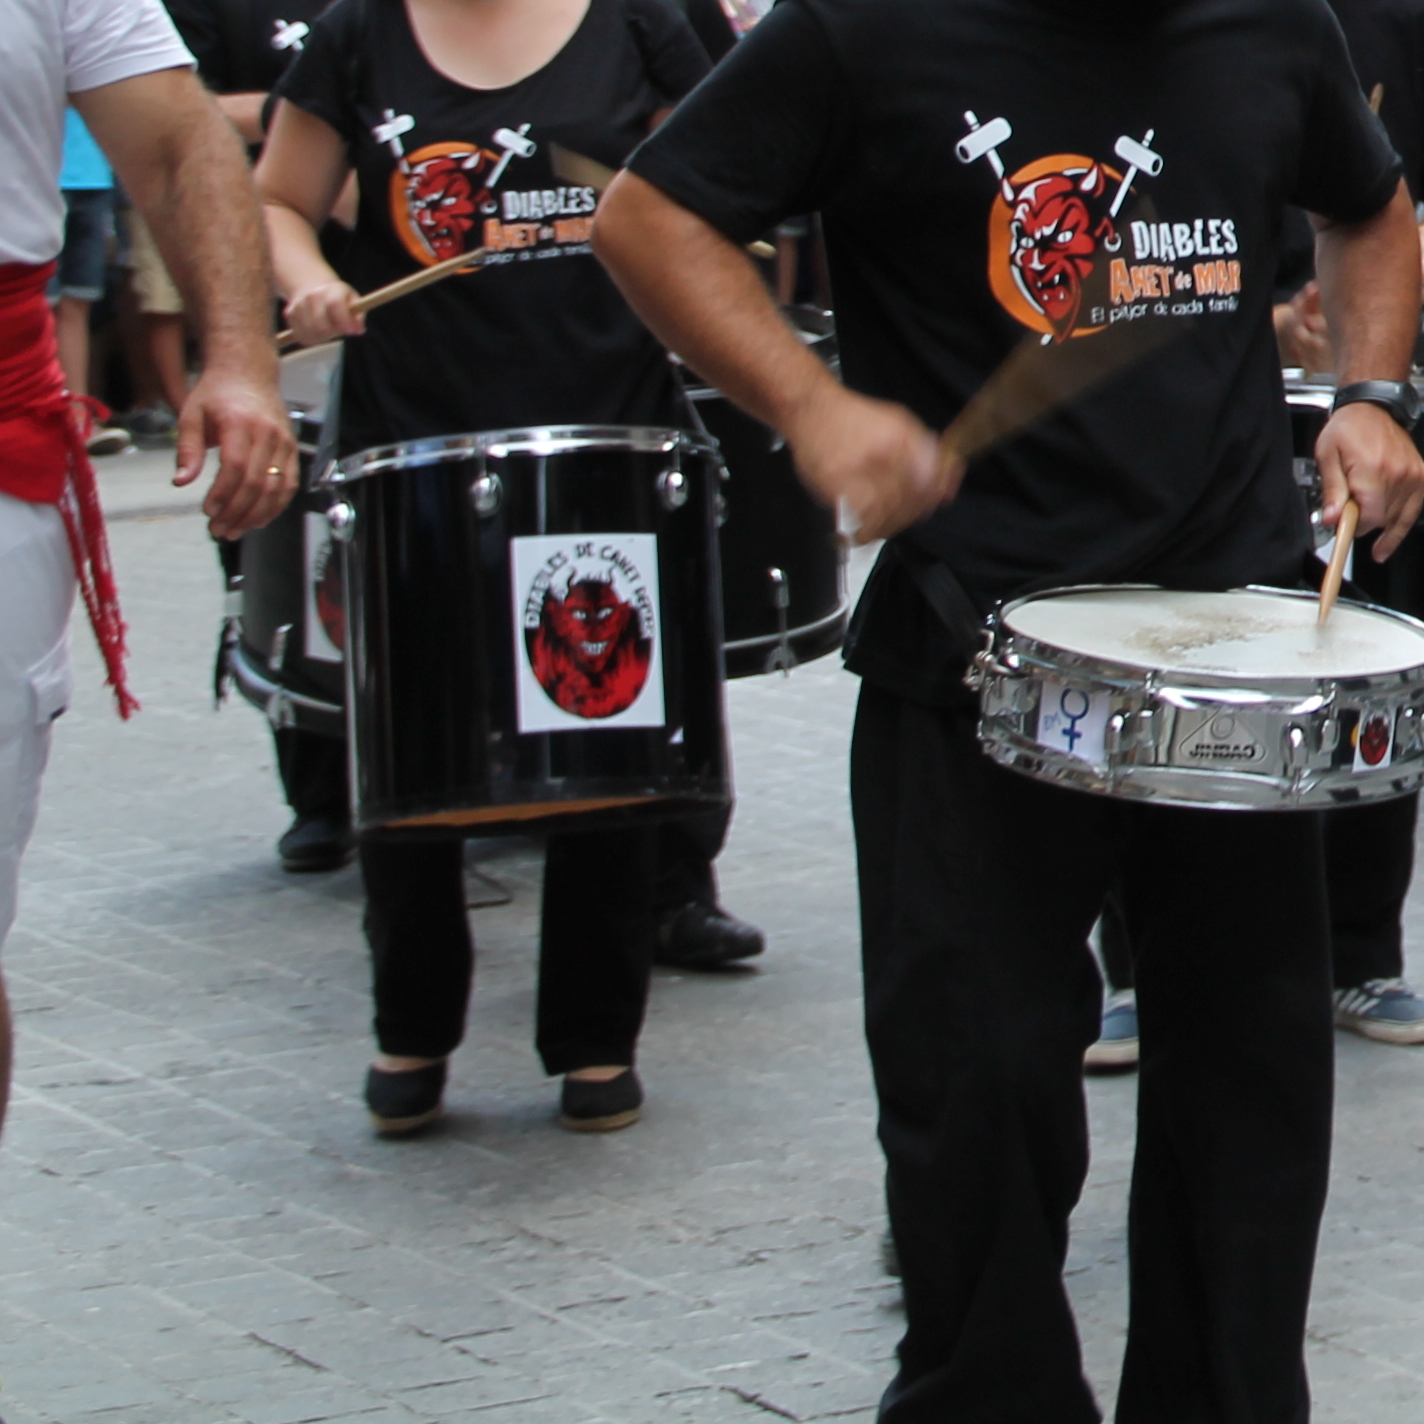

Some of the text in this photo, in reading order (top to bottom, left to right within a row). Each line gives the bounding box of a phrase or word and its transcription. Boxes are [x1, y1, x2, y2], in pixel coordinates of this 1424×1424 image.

[502, 186, 597, 221] DIABLES
[1130, 218, 1239, 263] DIABLES
[1174, 270, 1193, 291] de
[1091, 306, 1105, 324] El
[1153, 300, 1168, 315] de
[1171, 298, 1204, 315] cada
[524, 549, 569, 629] DIABLES
[575, 541, 595, 559] DE
[600, 544, 642, 584] CANET
